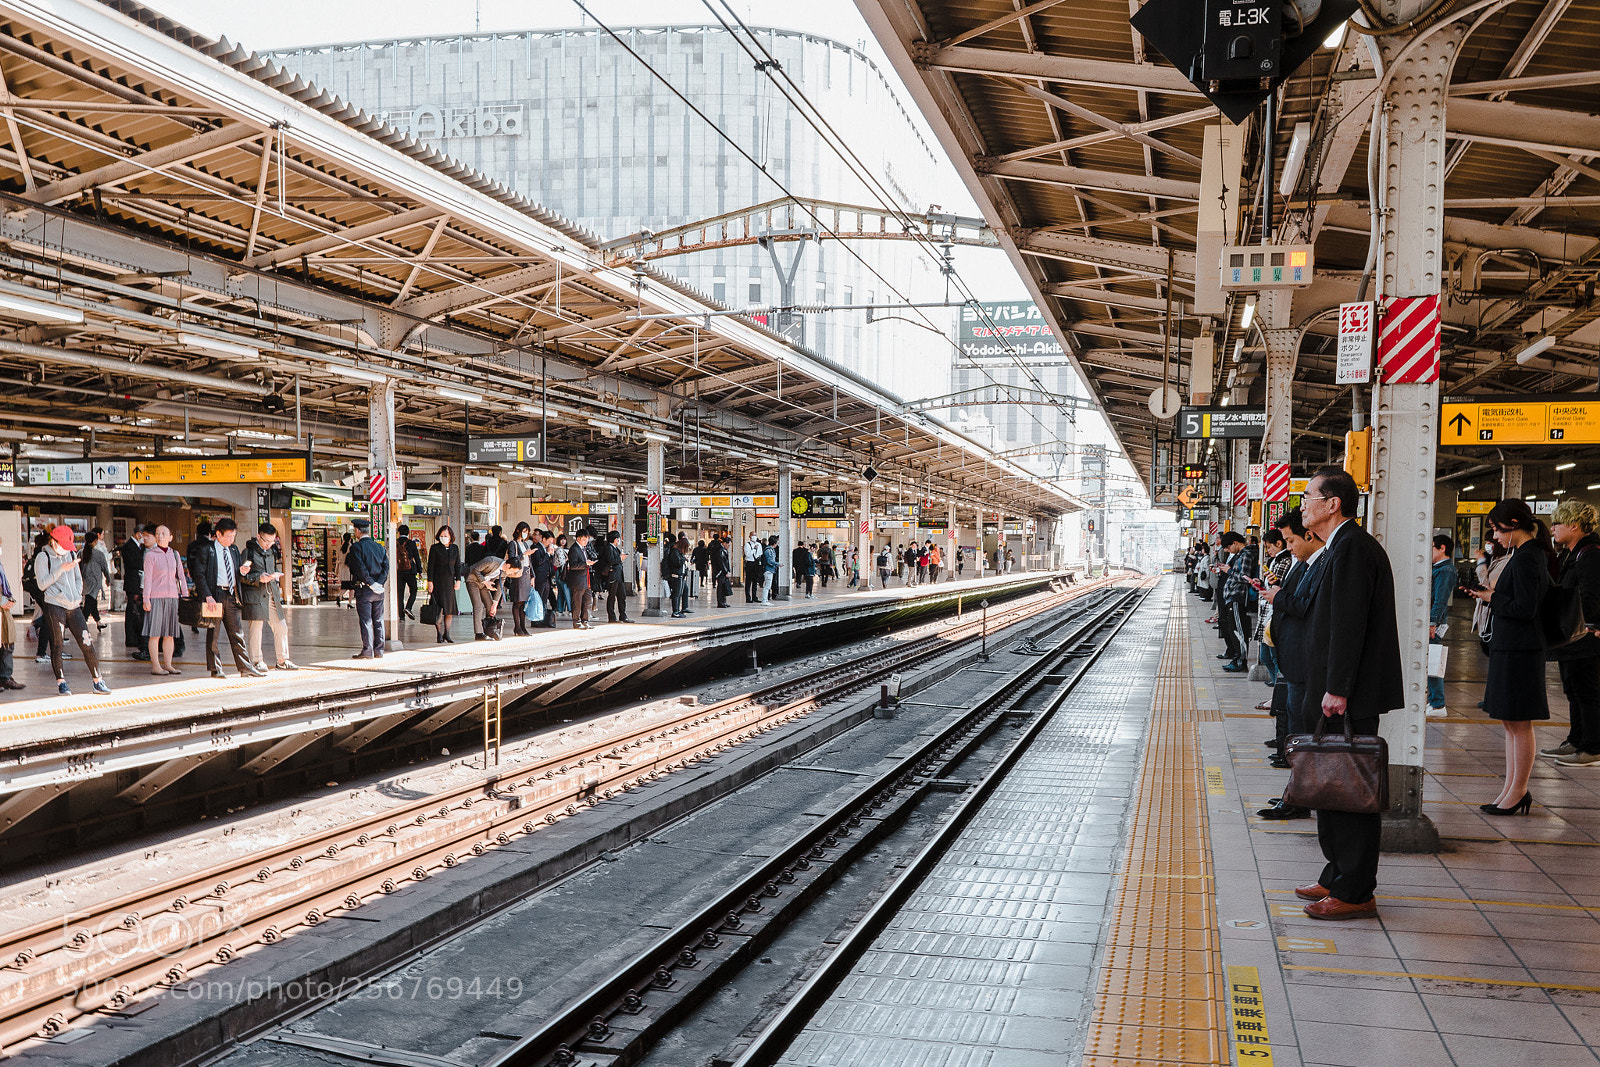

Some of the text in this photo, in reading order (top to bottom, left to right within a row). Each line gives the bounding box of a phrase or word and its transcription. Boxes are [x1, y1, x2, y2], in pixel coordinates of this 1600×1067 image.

[1218, 7, 1271, 27] 電上3K
[410, 103, 523, 139] Akiba
[971, 325, 1055, 338] マルチメディアA
[1342, 335, 1368, 343] 非常停止
[1341, 344, 1361, 352] ボタン
[1482, 408, 1524, 416] 電気街改札
[1553, 407, 1587, 415] 中央改札
[1186, 414, 1199, 435] 5
[1481, 430, 1492, 439] 1F
[1552, 429, 1563, 439] 1F
[526, 440, 537, 458] 6
[1183, 509, 1190, 518] 5
[1232, 984, 1270, 1058] 5号車乗車口
